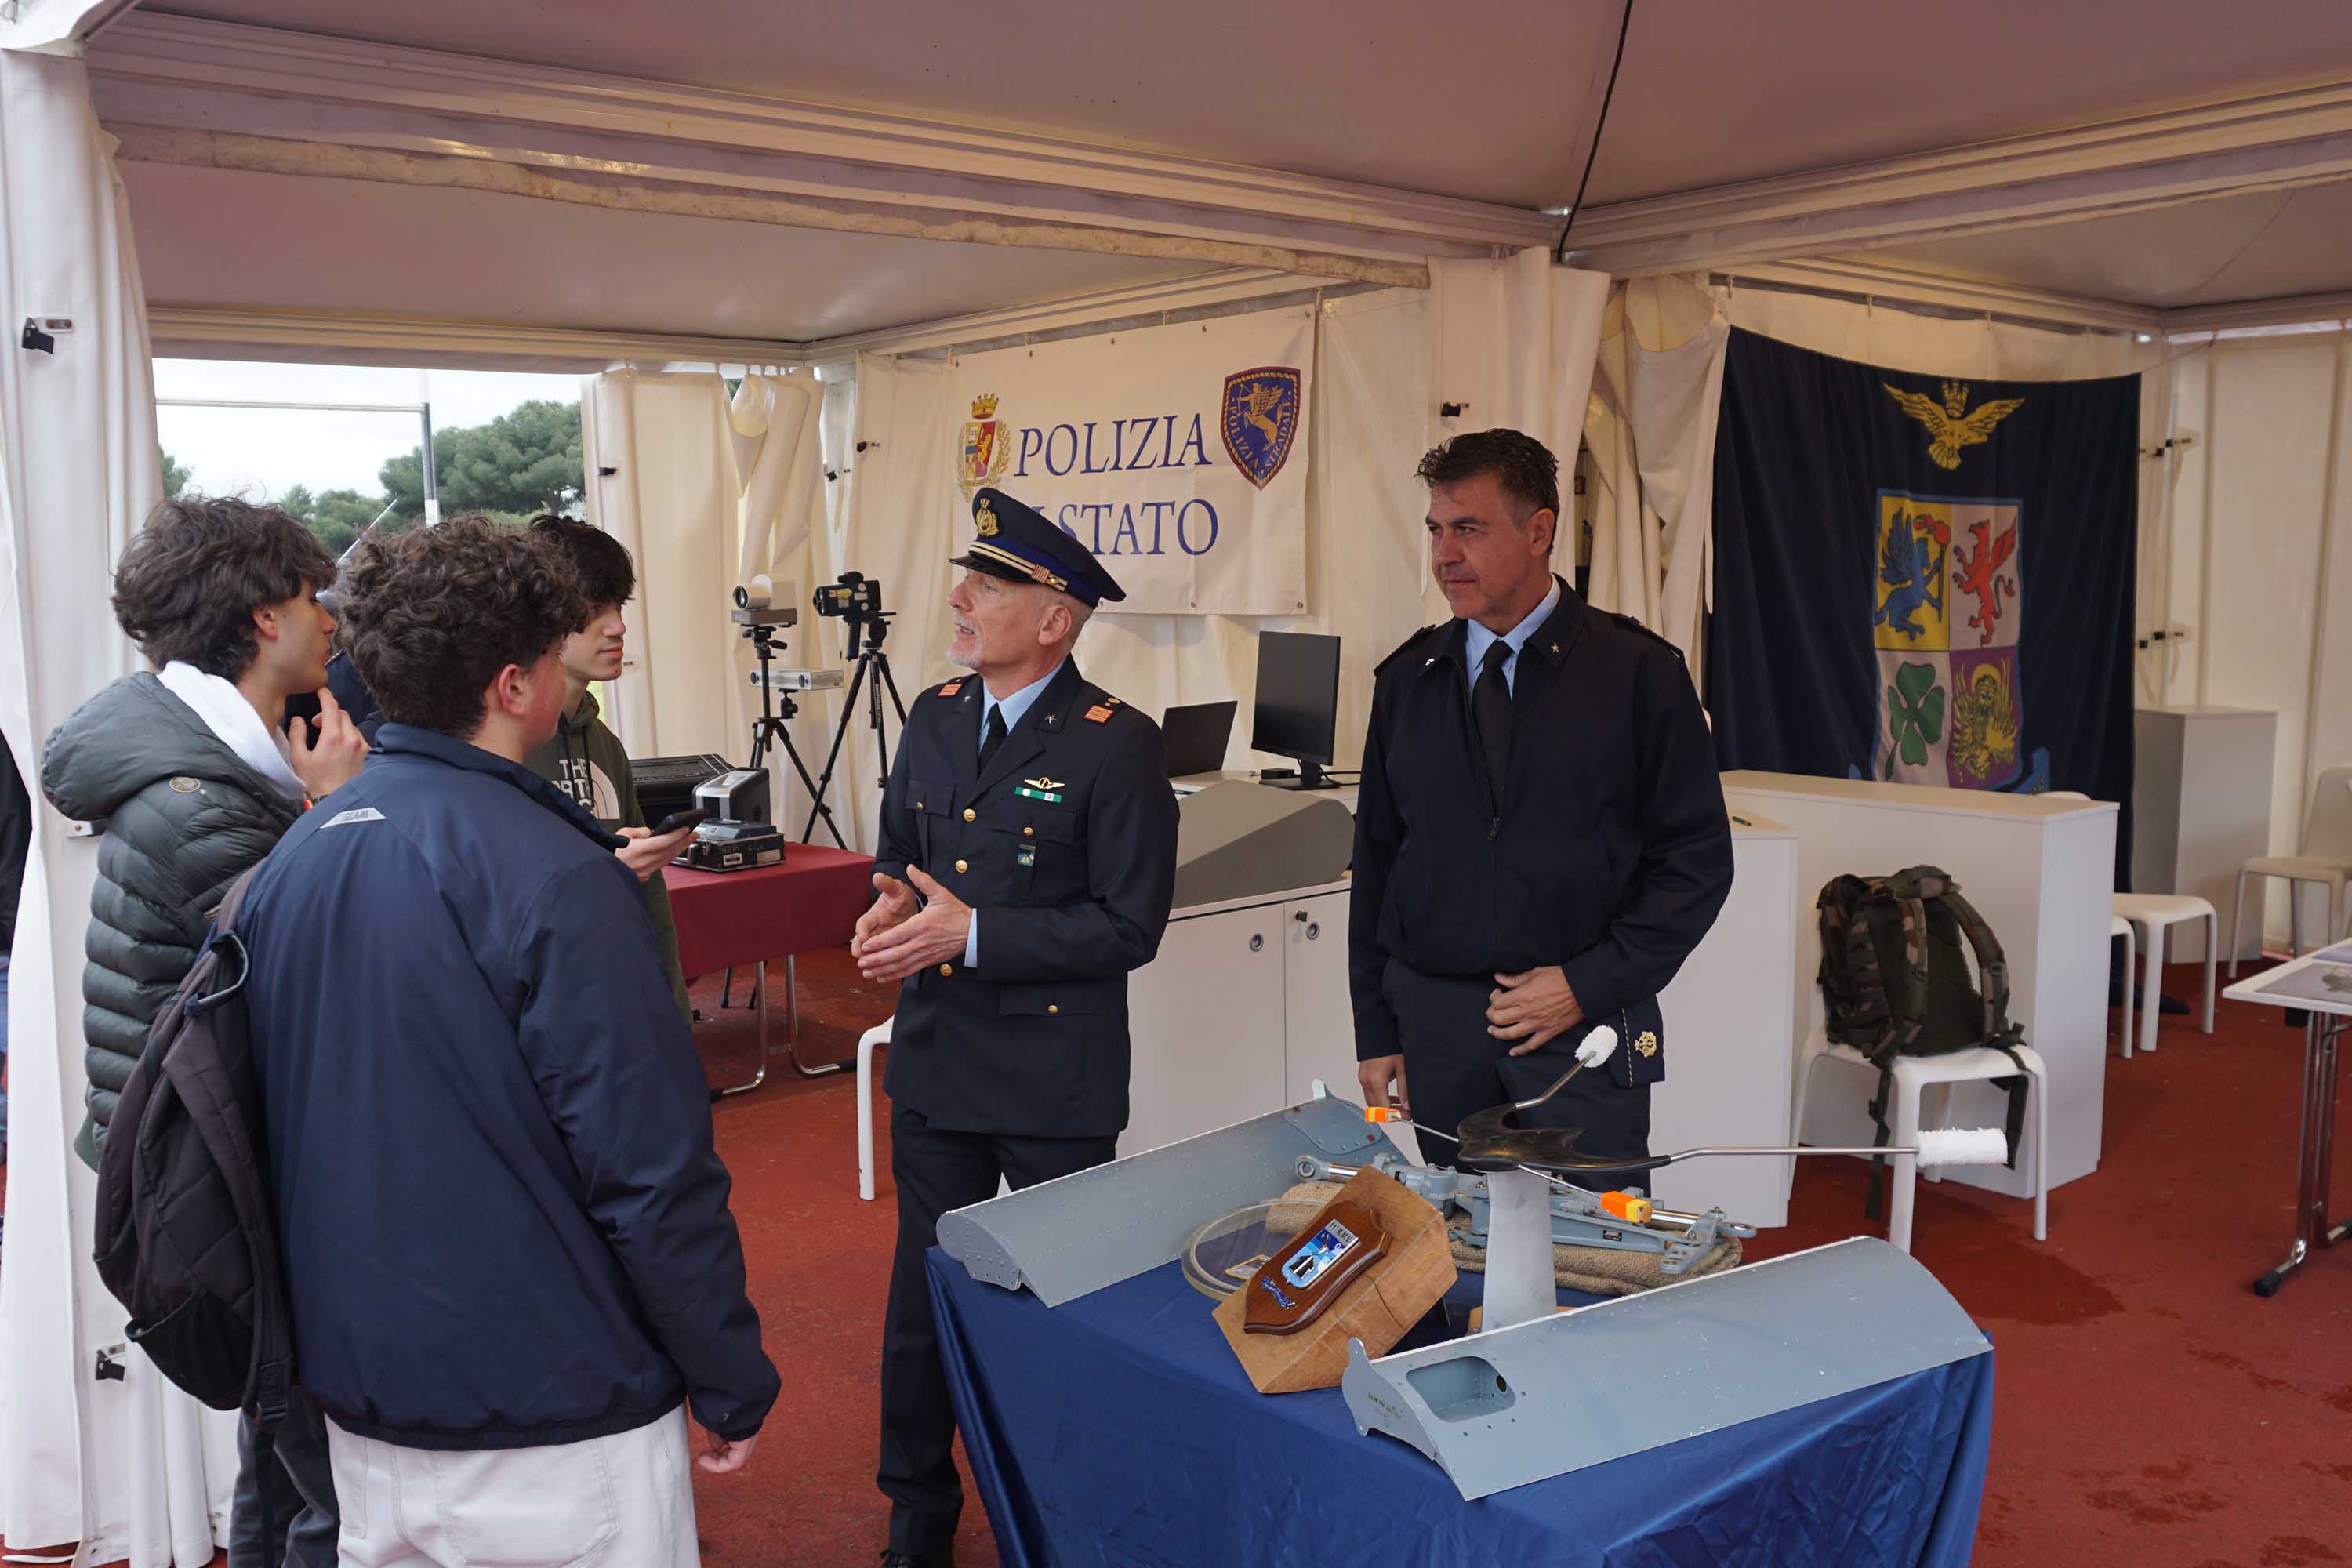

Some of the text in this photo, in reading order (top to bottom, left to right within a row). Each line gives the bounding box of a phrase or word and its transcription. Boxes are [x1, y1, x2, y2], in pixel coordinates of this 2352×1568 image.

[1014, 413, 1212, 476] POLIZIA
[1229, 406, 1258, 469] POLIZIA
[1263, 399, 1291, 470] STRADALE
[1058, 499, 1218, 555] STATO
